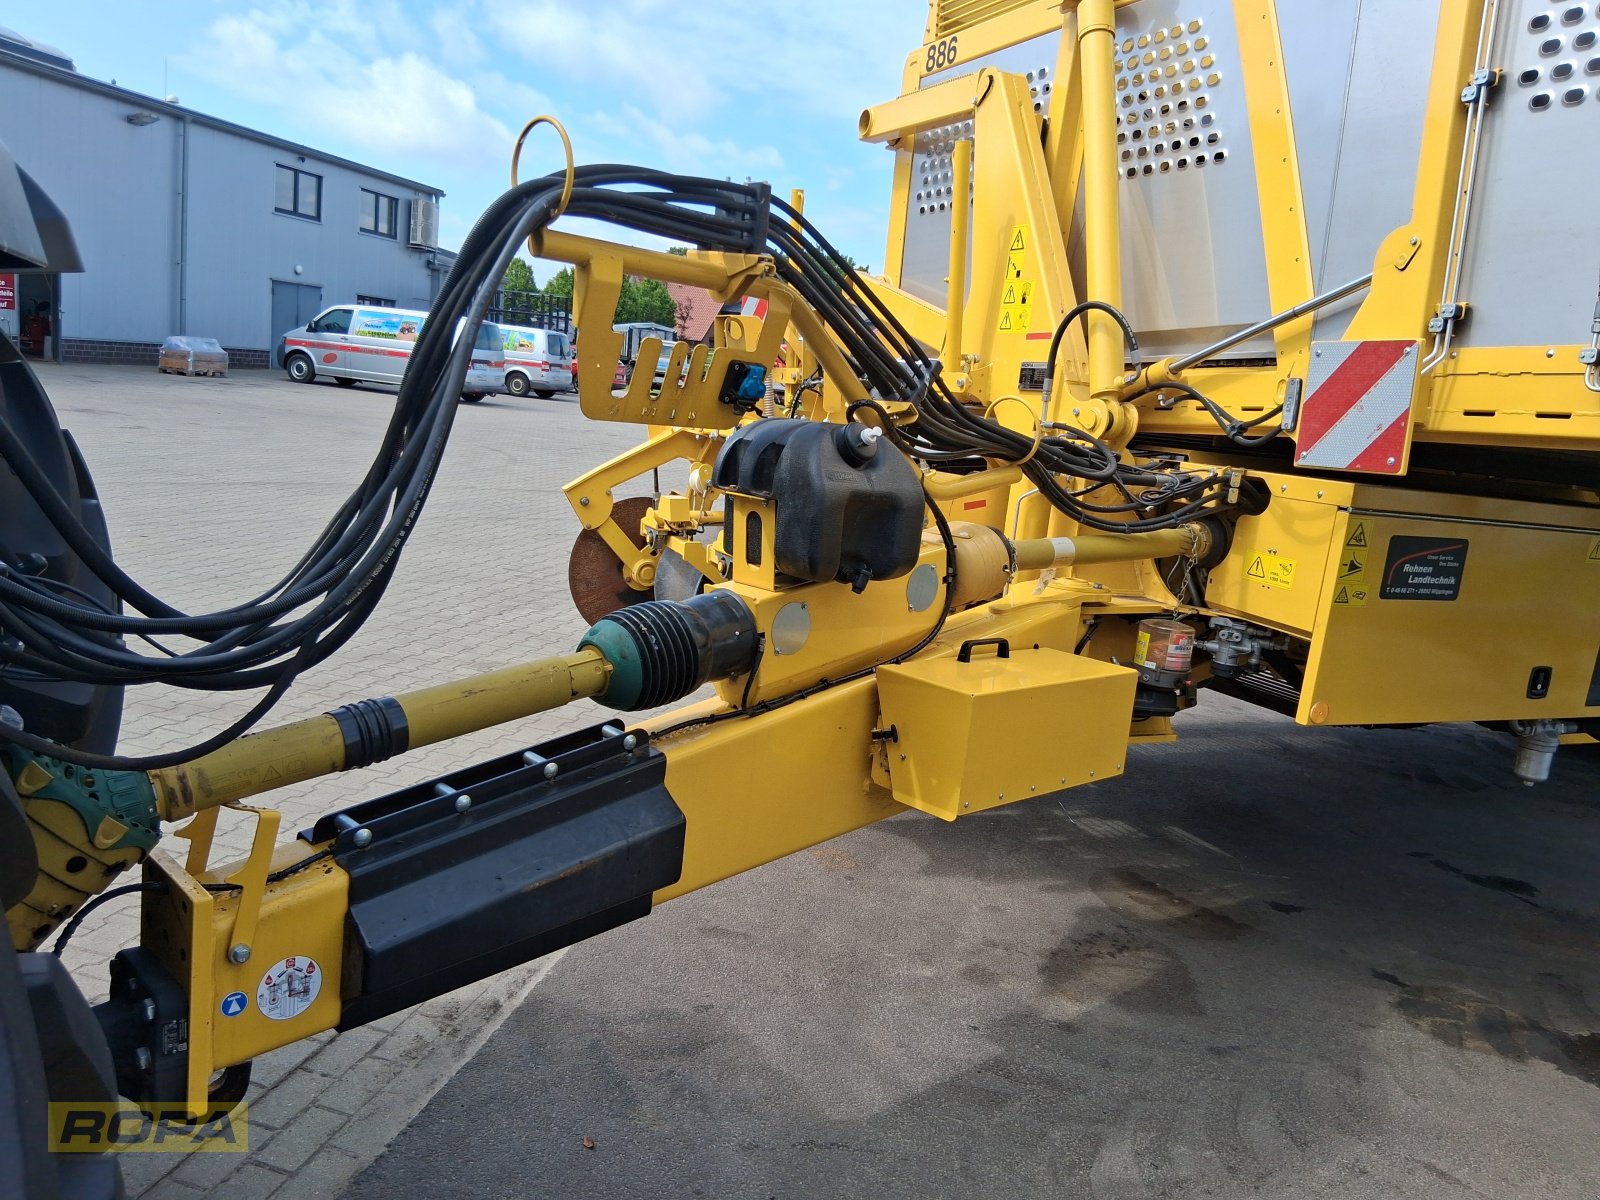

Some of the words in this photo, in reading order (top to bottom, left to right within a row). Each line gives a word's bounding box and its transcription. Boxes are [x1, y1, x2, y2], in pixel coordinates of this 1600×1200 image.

[926, 36, 958, 72] 886
[1403, 563, 1433, 573] Rehnen
[1408, 575, 1456, 585] Landtechnik
